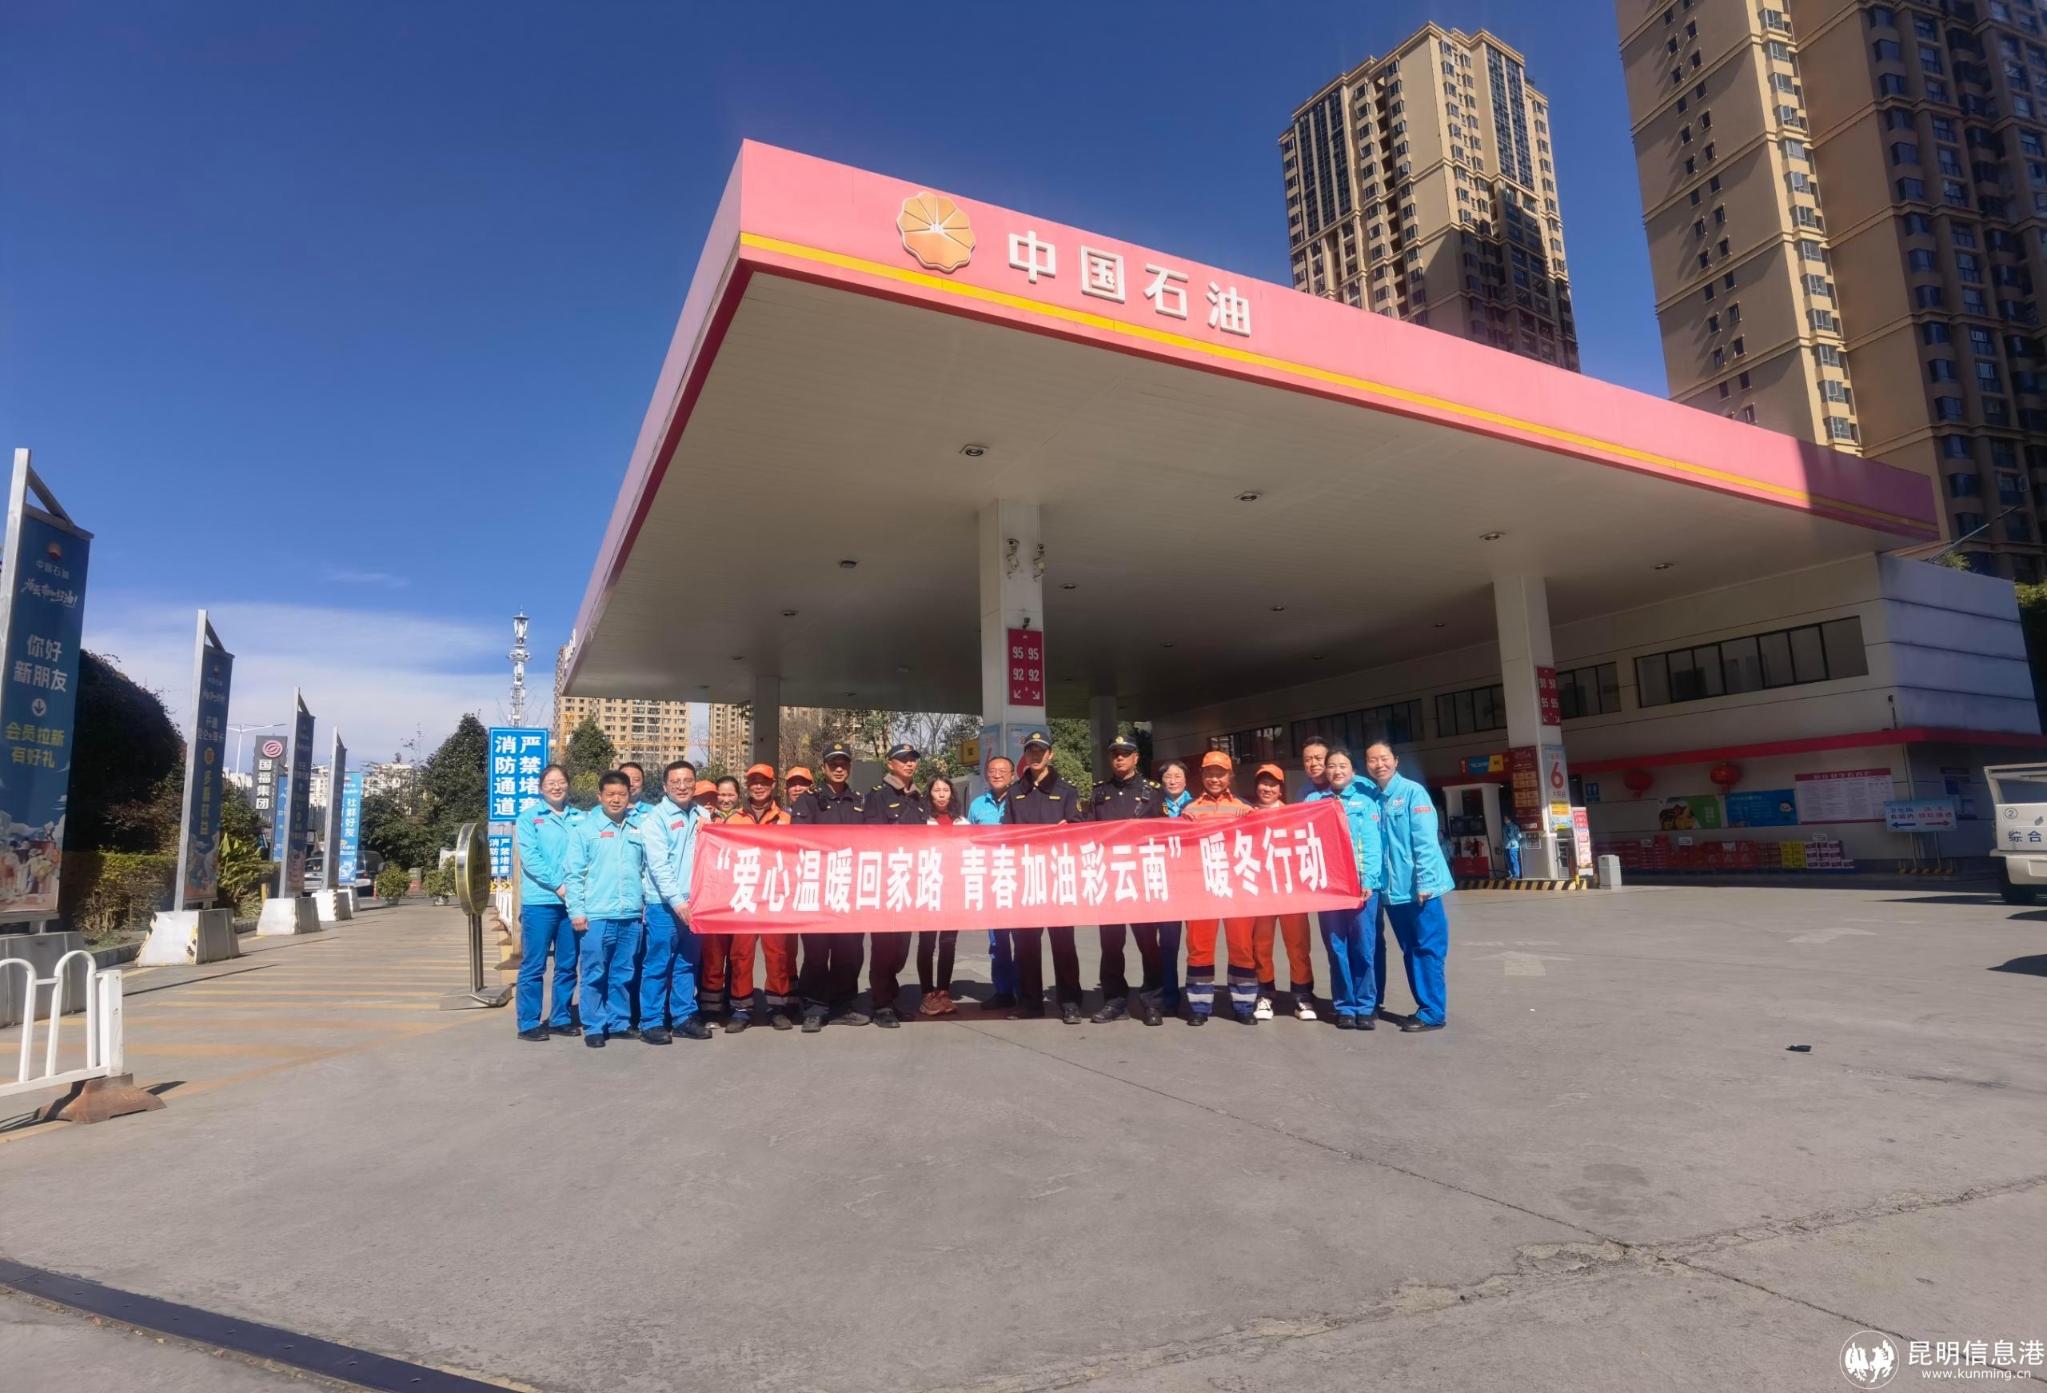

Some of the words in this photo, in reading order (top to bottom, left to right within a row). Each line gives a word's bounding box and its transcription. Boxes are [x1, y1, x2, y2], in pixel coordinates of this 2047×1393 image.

[1008, 229, 1251, 337] 中国石油
[27, 634, 62, 662] 你好
[1012, 646, 1024, 659] 95
[1028, 647, 1039, 661] 95
[13, 660, 68, 692] 新朋友
[1013, 668, 1024, 681] 92
[1028, 669, 1040, 682] 92
[1541, 697, 1549, 709] 95
[1550, 697, 1559, 709] 95
[6, 722, 64, 748] 会员拉新
[11, 746, 55, 768] 有好礼
[256, 759, 272, 810] 国福集团
[494, 735, 517, 816] 消防通道
[1550, 762, 1564, 789] 6
[345, 798, 356, 837] 社群好友
[500, 838, 511, 875] 严禁堵塞
[716, 846, 944, 914] “爱心温暖回家路
[960, 836, 1182, 911] 青春加油彩云南”
[1199, 821, 1328, 899] 暖冬行动
